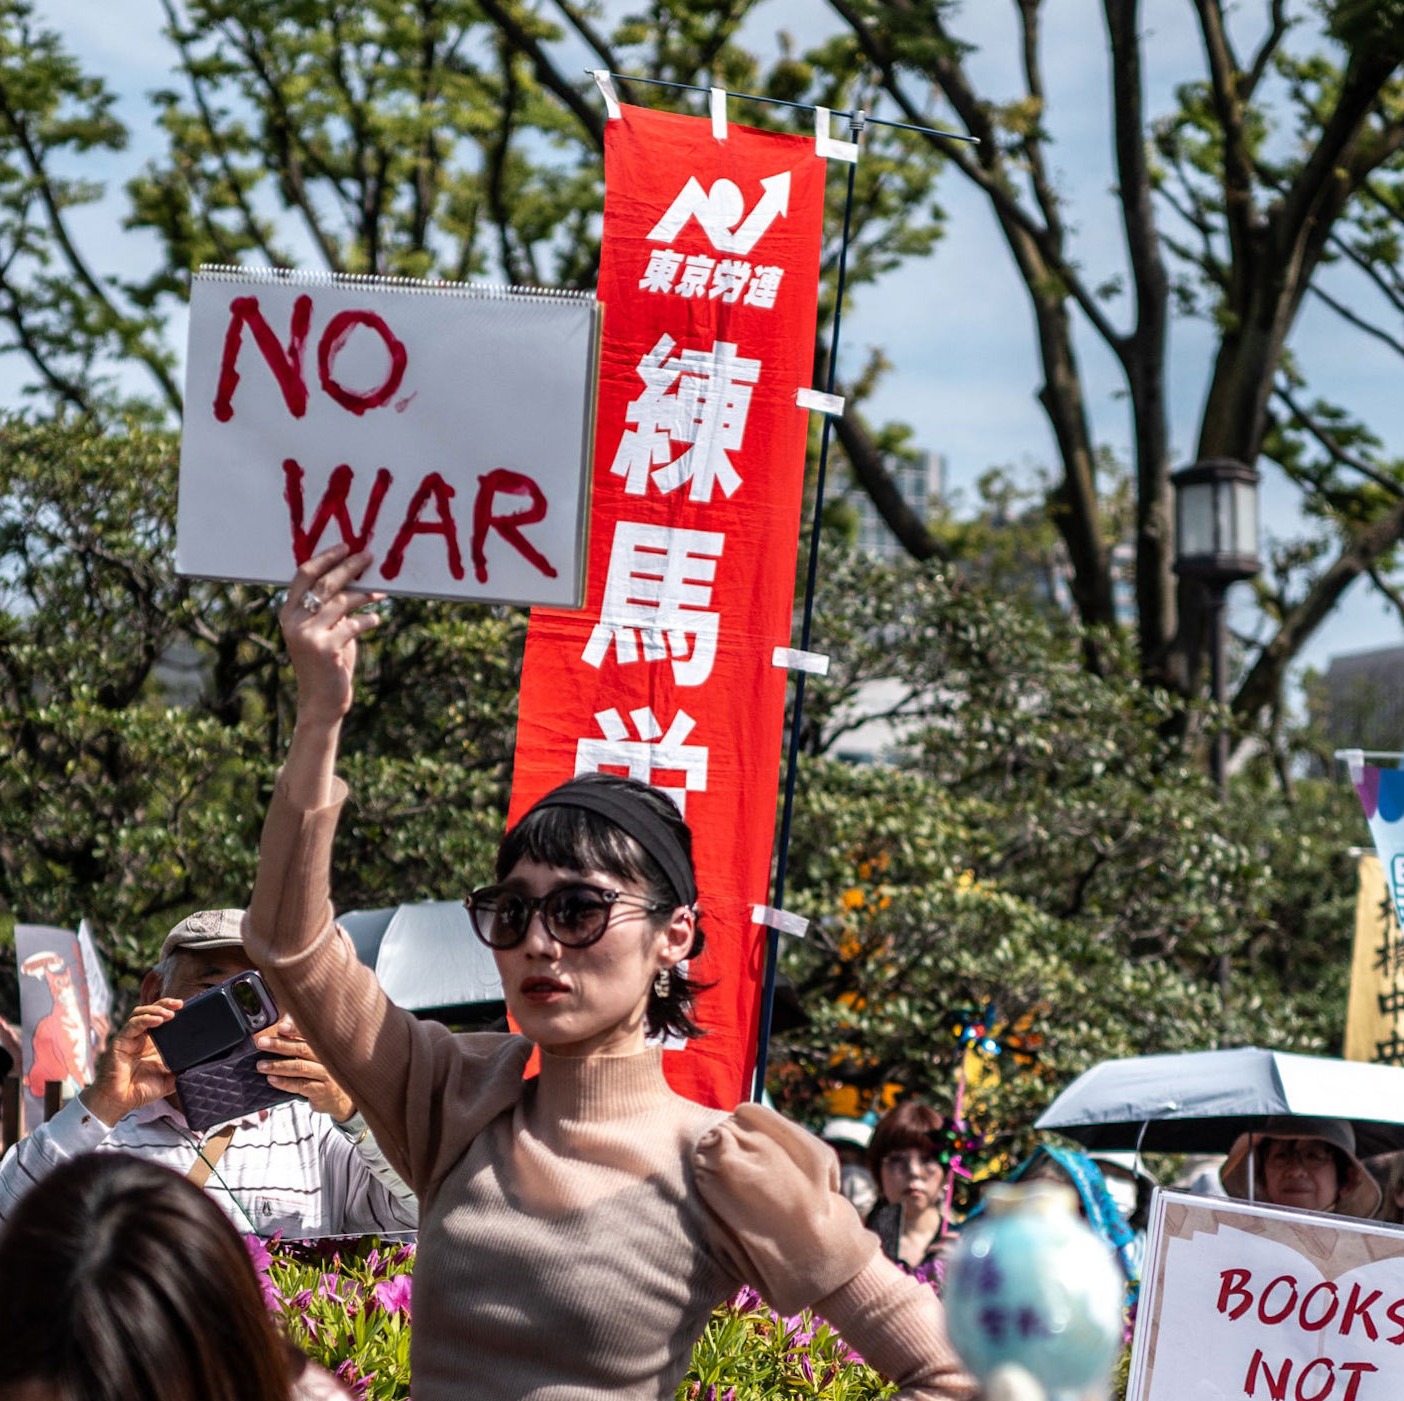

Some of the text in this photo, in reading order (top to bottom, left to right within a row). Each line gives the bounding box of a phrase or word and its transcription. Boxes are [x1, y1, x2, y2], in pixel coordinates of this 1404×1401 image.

[638, 248, 784, 310] 東京労連
[283, 459, 558, 585] WAR
